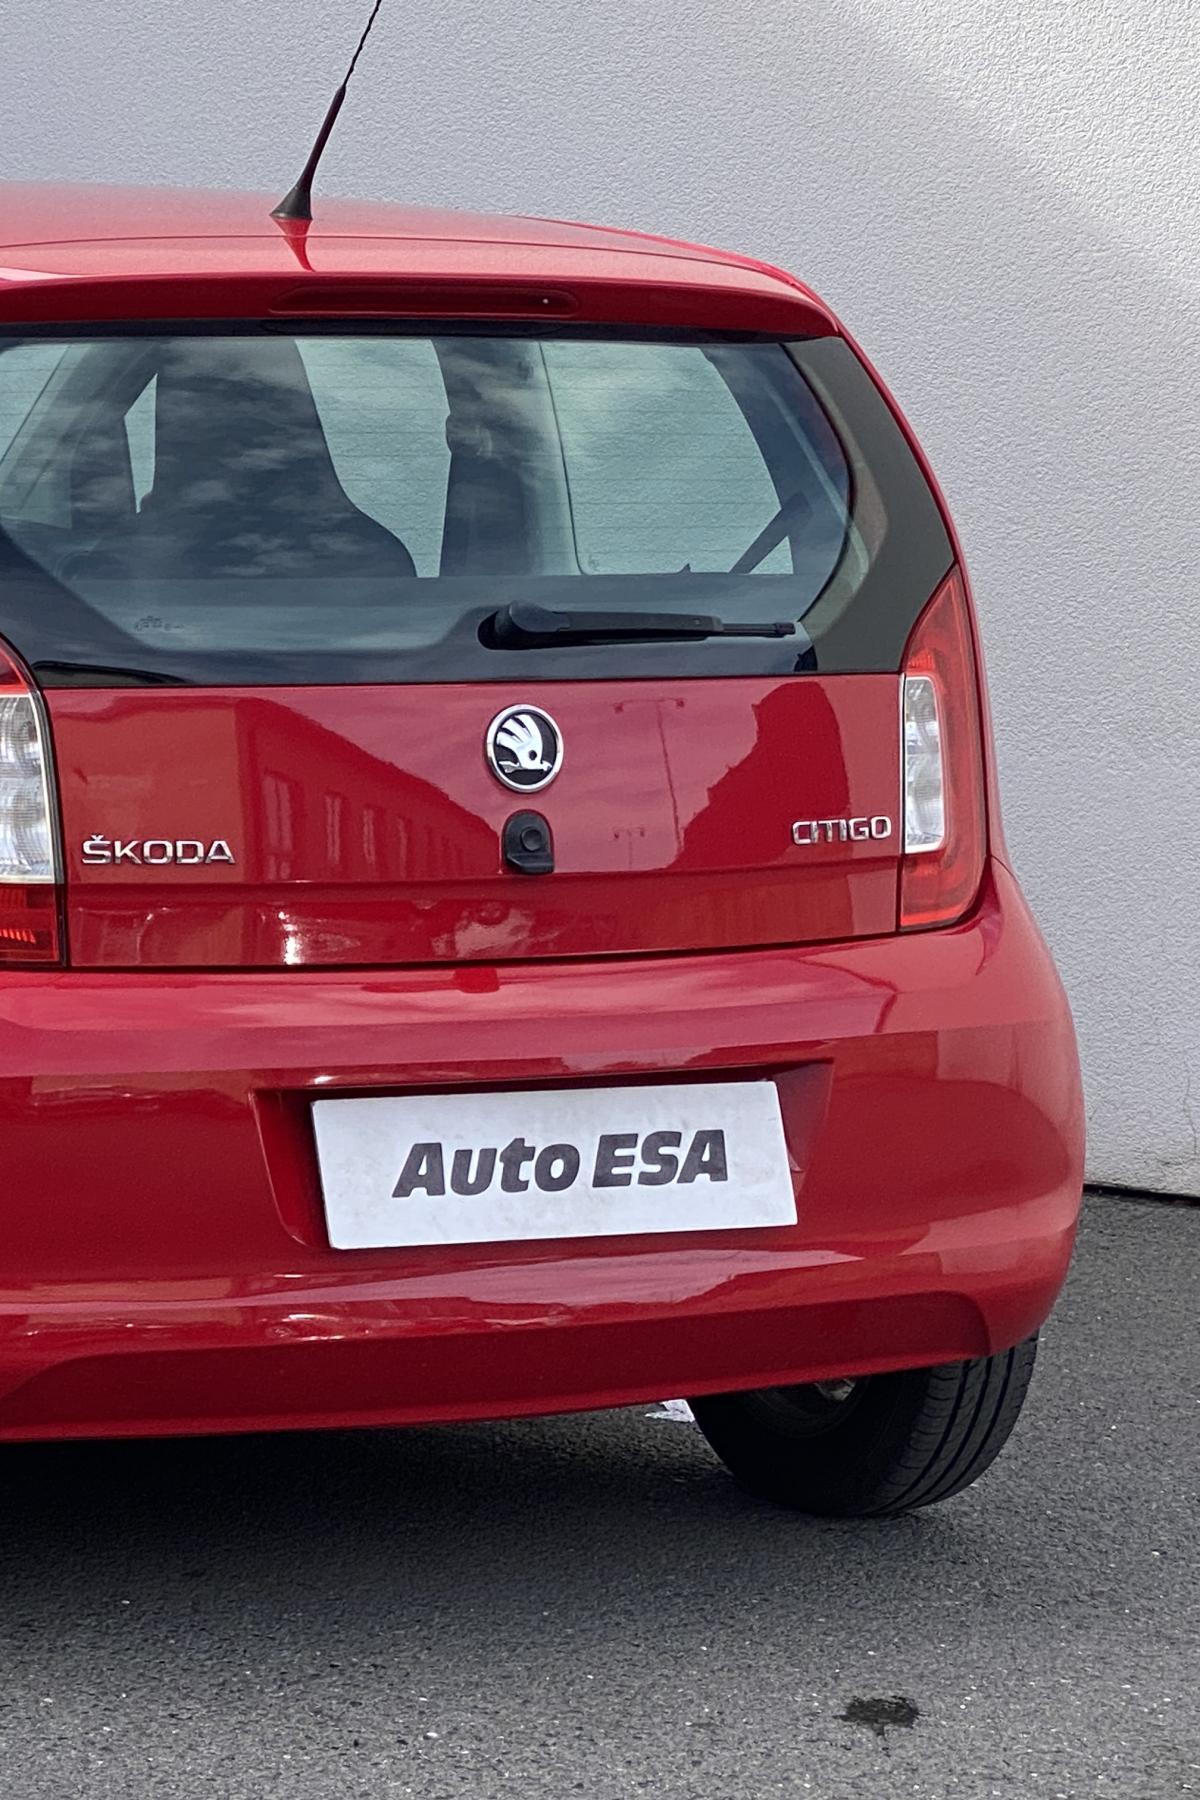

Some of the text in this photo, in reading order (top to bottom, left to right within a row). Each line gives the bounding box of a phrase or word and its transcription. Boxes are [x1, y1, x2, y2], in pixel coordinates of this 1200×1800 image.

[792, 816, 892, 845] CITIGO
[81, 834, 236, 866] ŠKODA
[391, 1129, 729, 1199] Auto ESA
